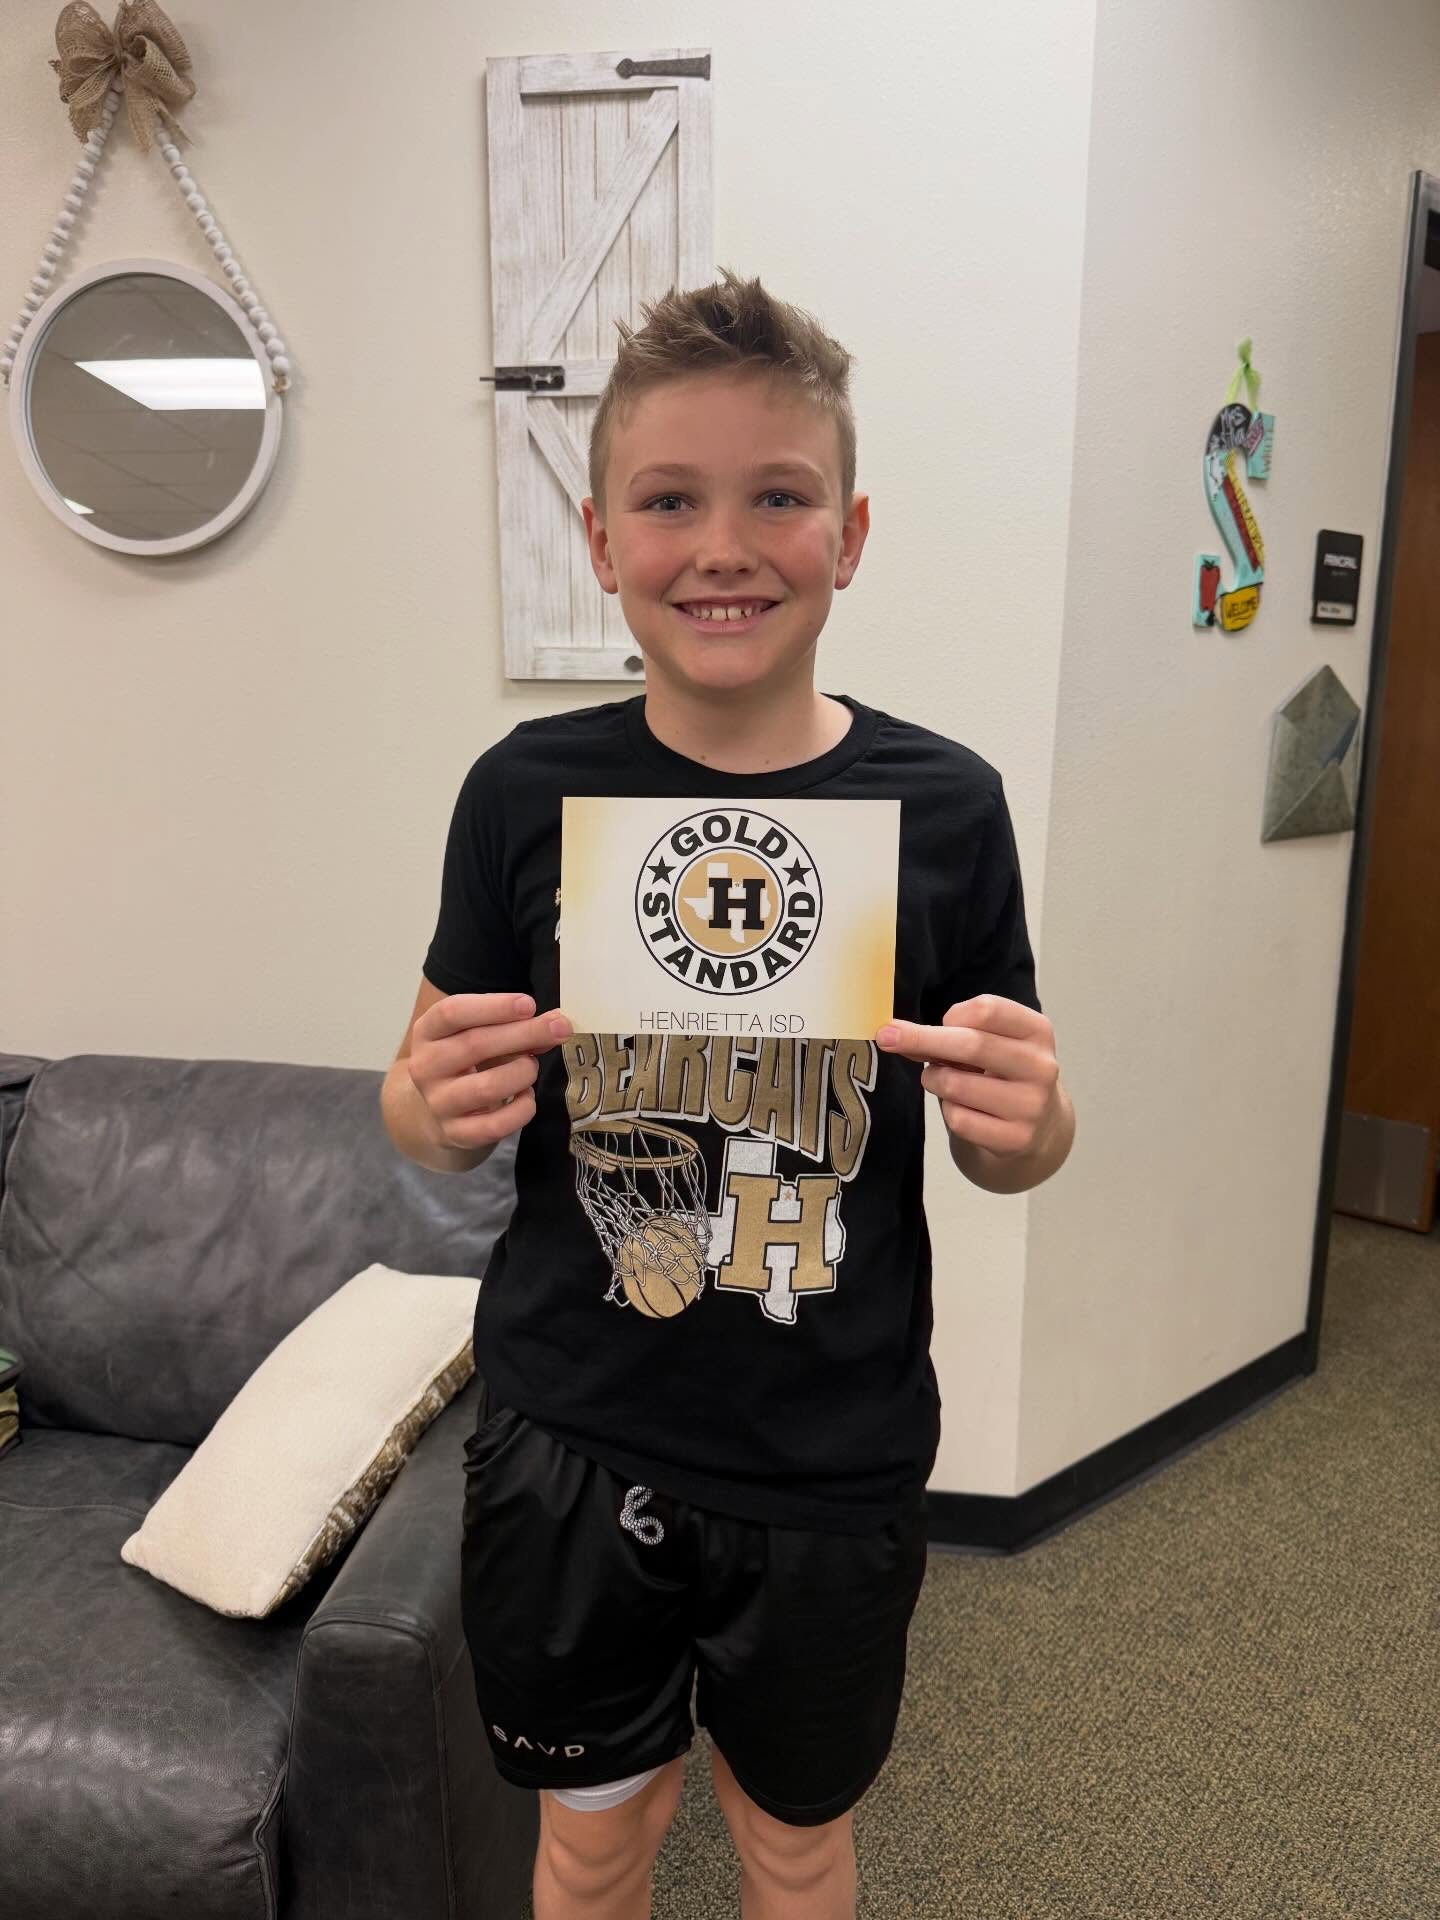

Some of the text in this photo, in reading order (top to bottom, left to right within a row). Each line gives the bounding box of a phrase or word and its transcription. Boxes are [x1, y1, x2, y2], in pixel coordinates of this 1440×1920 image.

[670, 814, 788, 859] GOLD
[642, 891, 816, 990] STANDARD
[708, 877, 766, 930] H
[639, 1011, 805, 1034] HENRIETTA ISD
[562, 1033, 876, 1182] BEARCATS
[717, 1172, 840, 1293] H
